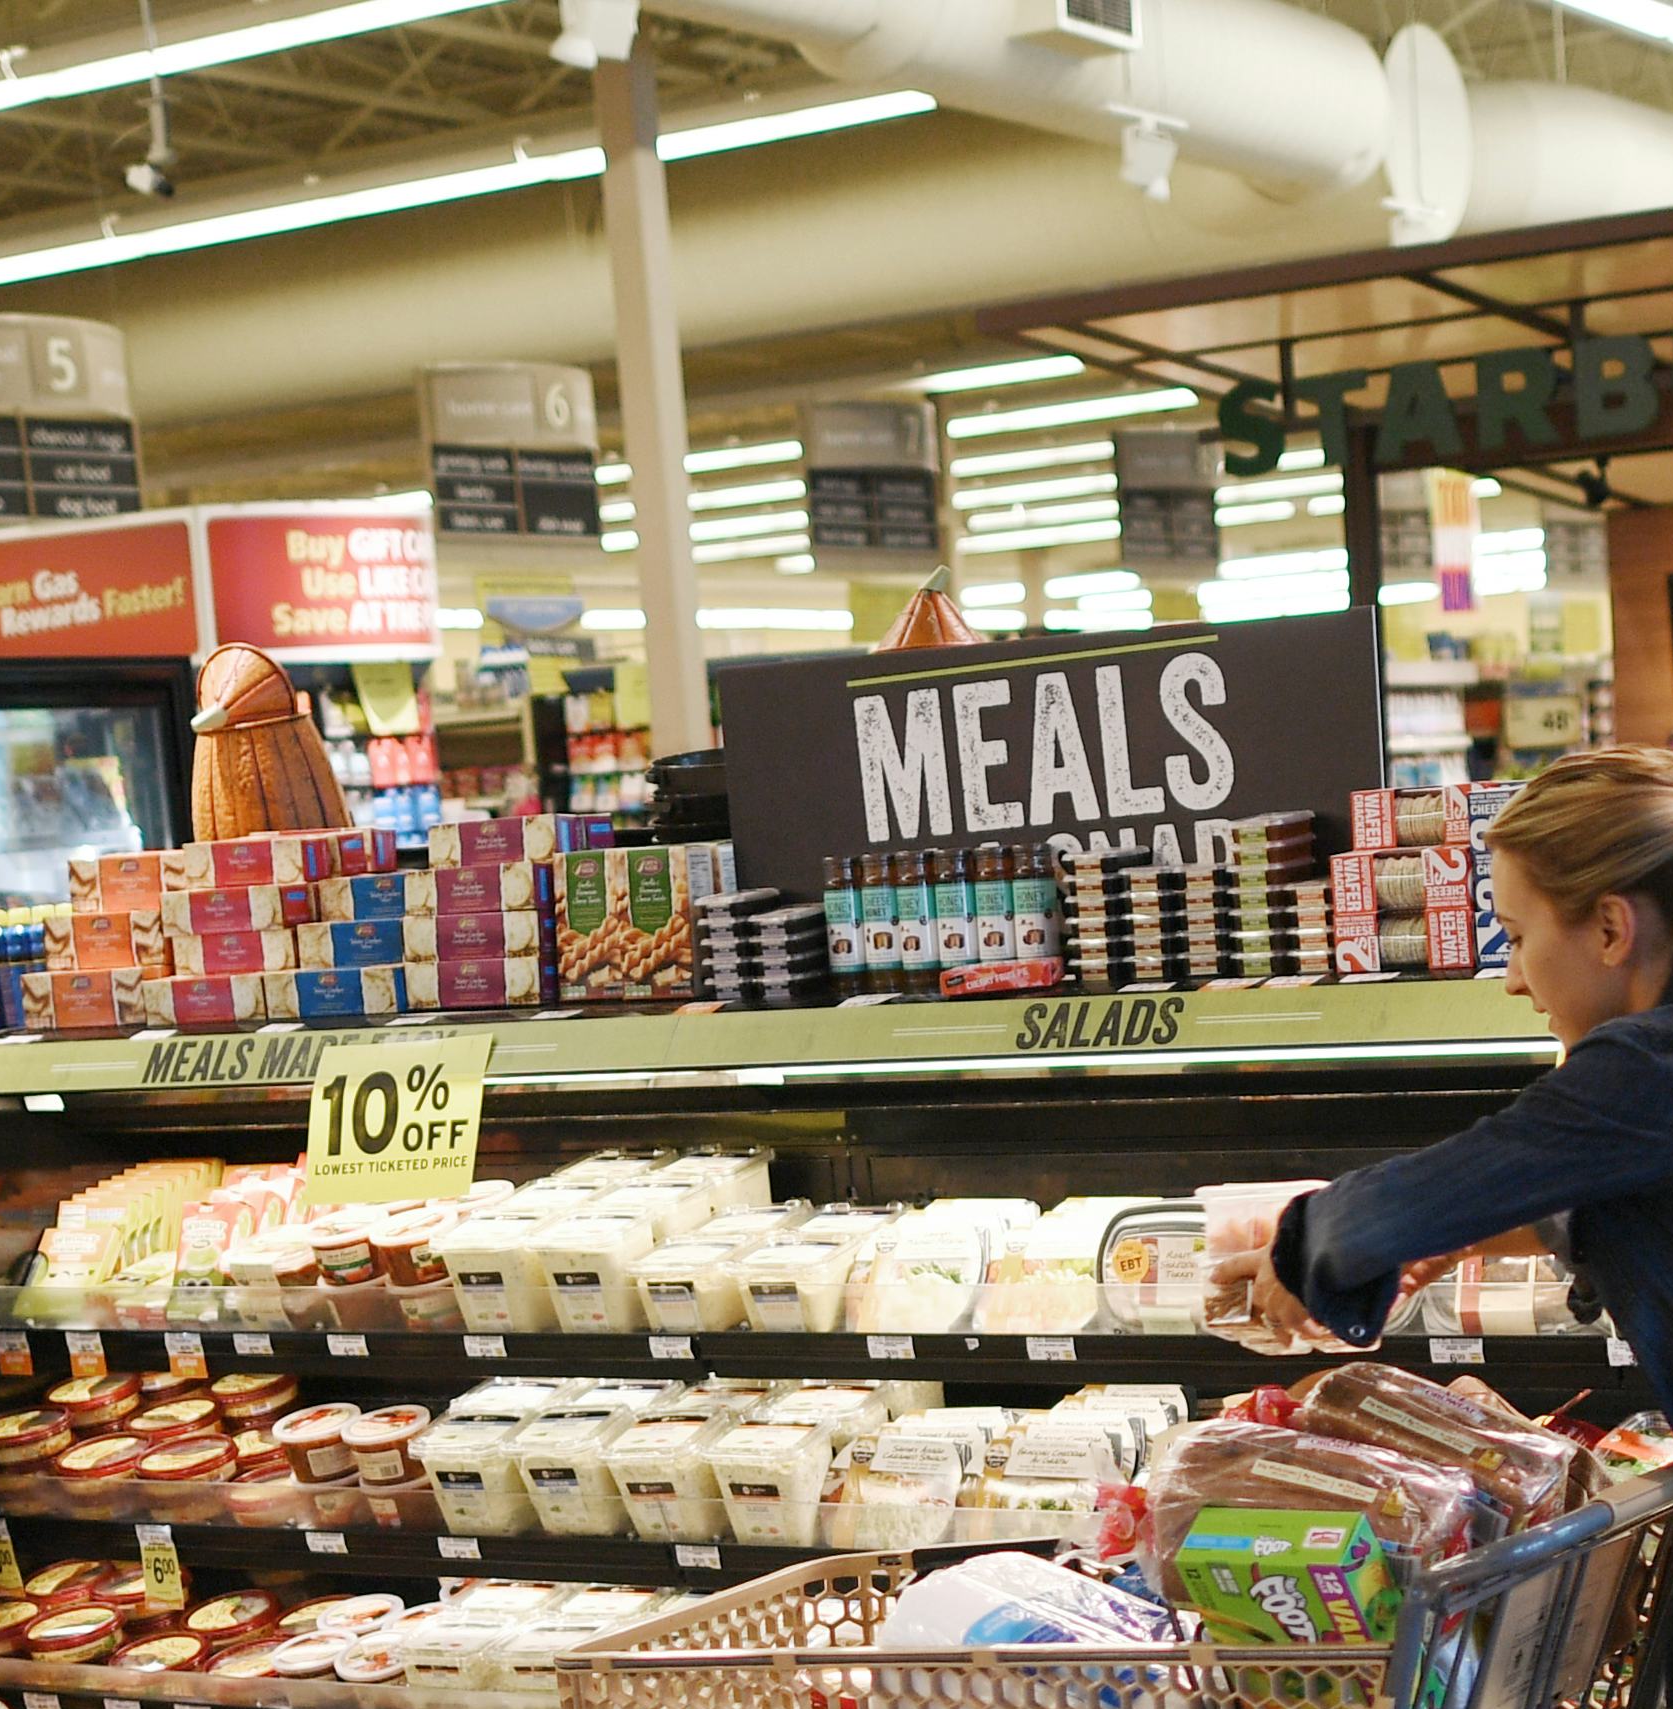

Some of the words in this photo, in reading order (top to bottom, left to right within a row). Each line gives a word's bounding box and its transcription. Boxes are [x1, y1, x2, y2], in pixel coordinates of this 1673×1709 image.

[48, 337, 77, 391] 5
[546, 383, 570, 428] 6
[286, 530, 347, 567] Buy
[348, 528, 402, 560] GIFT
[32, 569, 80, 601] Gas
[302, 565, 357, 599] Use
[0, 591, 102, 638] Rewards
[103, 575, 186, 620] Faster!
[271, 602, 348, 637] Save
[853, 651, 1234, 843] MEALS
[1366, 793, 1382, 847] WAFER
[1344, 857, 1362, 912] WAFER
[1441, 911, 1456, 965] WAFER
[1017, 996, 1184, 1051] SALADS
[142, 1038, 253, 1085] MEALS
[403, 1119, 469, 1153] OFF
[314, 1160, 364, 1177] LOWEST
[368, 1158, 429, 1174] TICKETED
[432, 1154, 469, 1170] PRICE
[1119, 1255, 1143, 1273] EBT
[1319, 1571, 1343, 1596] 12
